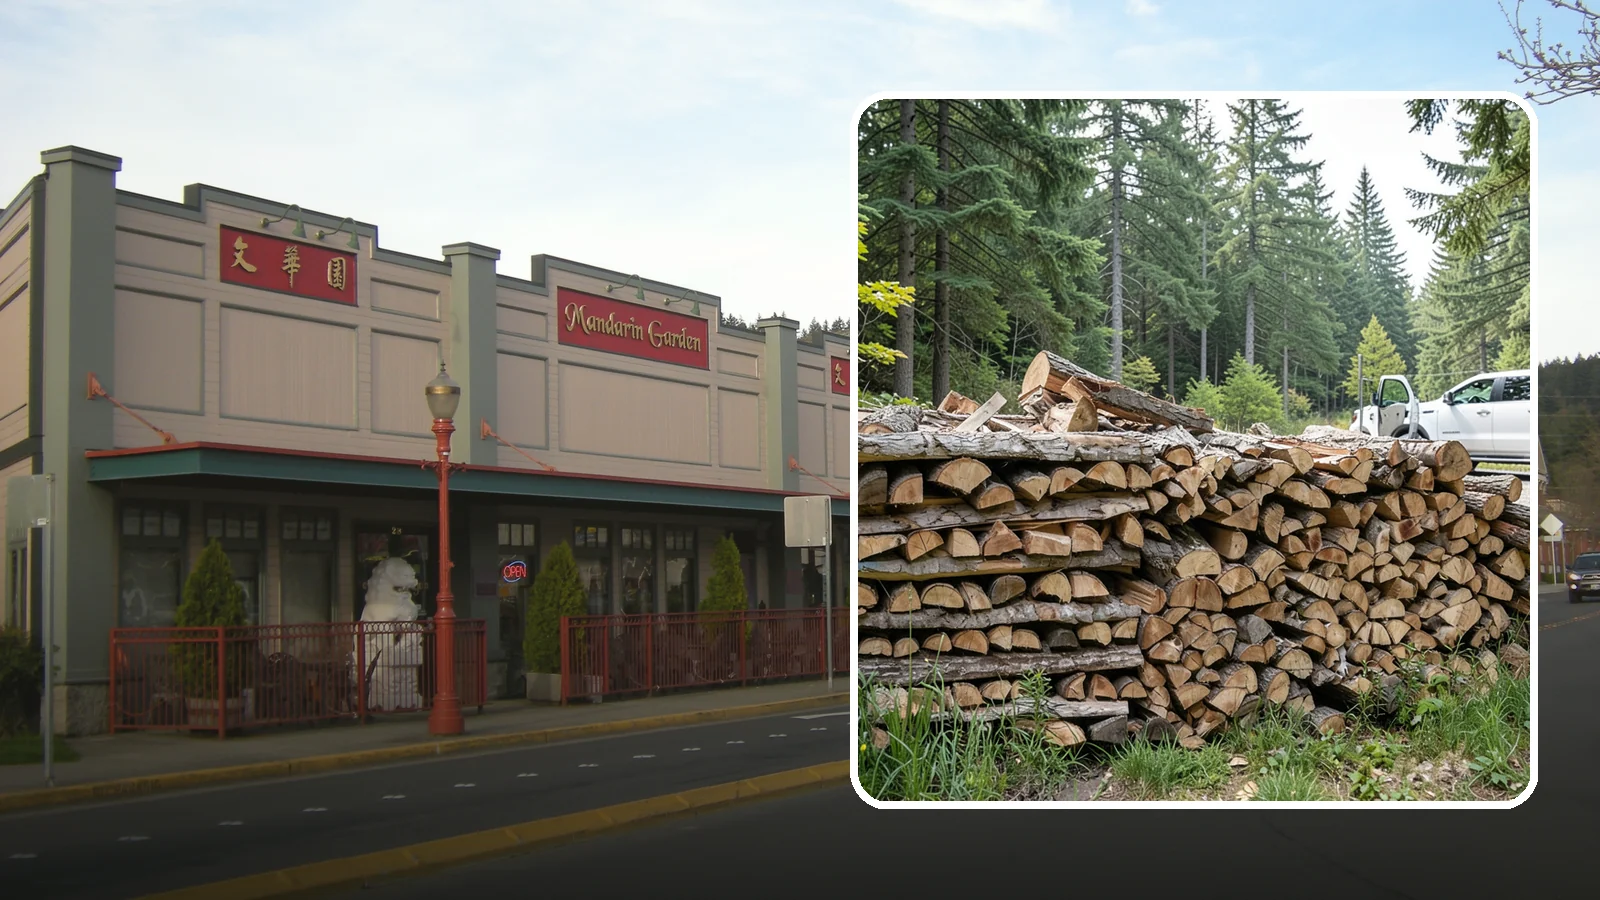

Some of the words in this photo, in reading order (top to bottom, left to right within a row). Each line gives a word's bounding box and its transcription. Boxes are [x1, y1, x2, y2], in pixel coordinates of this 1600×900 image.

[231, 236, 346, 291] 文華園
[565, 302, 643, 341] Mandarin
[648, 320, 701, 352] Garden
[503, 565, 527, 578] OPEN
